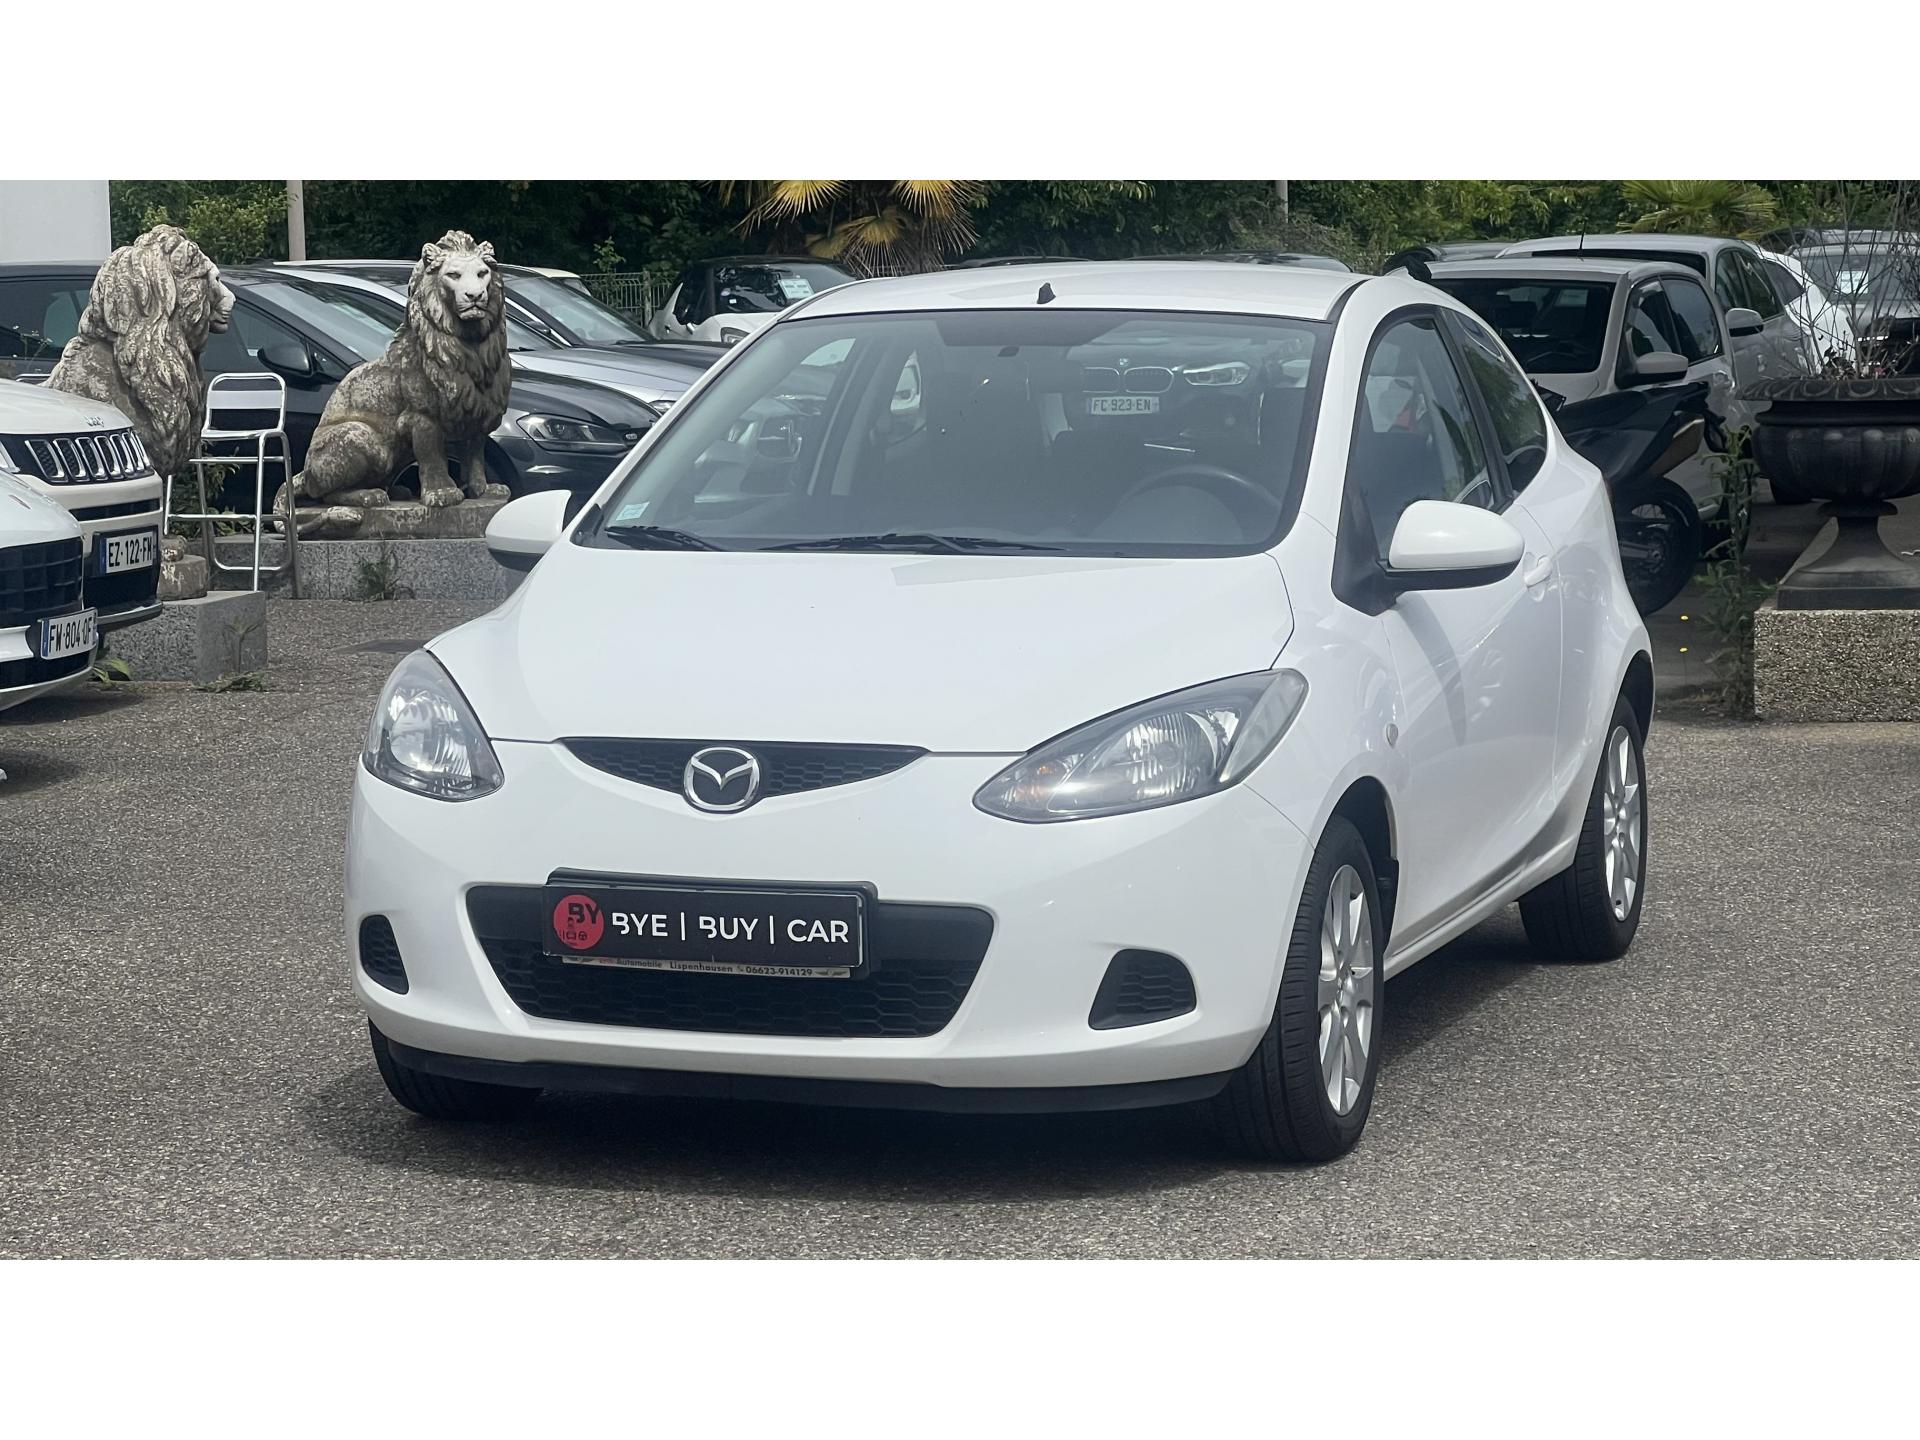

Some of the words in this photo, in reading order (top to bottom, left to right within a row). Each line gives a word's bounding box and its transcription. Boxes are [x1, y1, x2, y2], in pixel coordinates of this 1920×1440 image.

[611, 911, 668, 938] BYE
[699, 915, 759, 941] BUY
[786, 919, 849, 944] CAR
